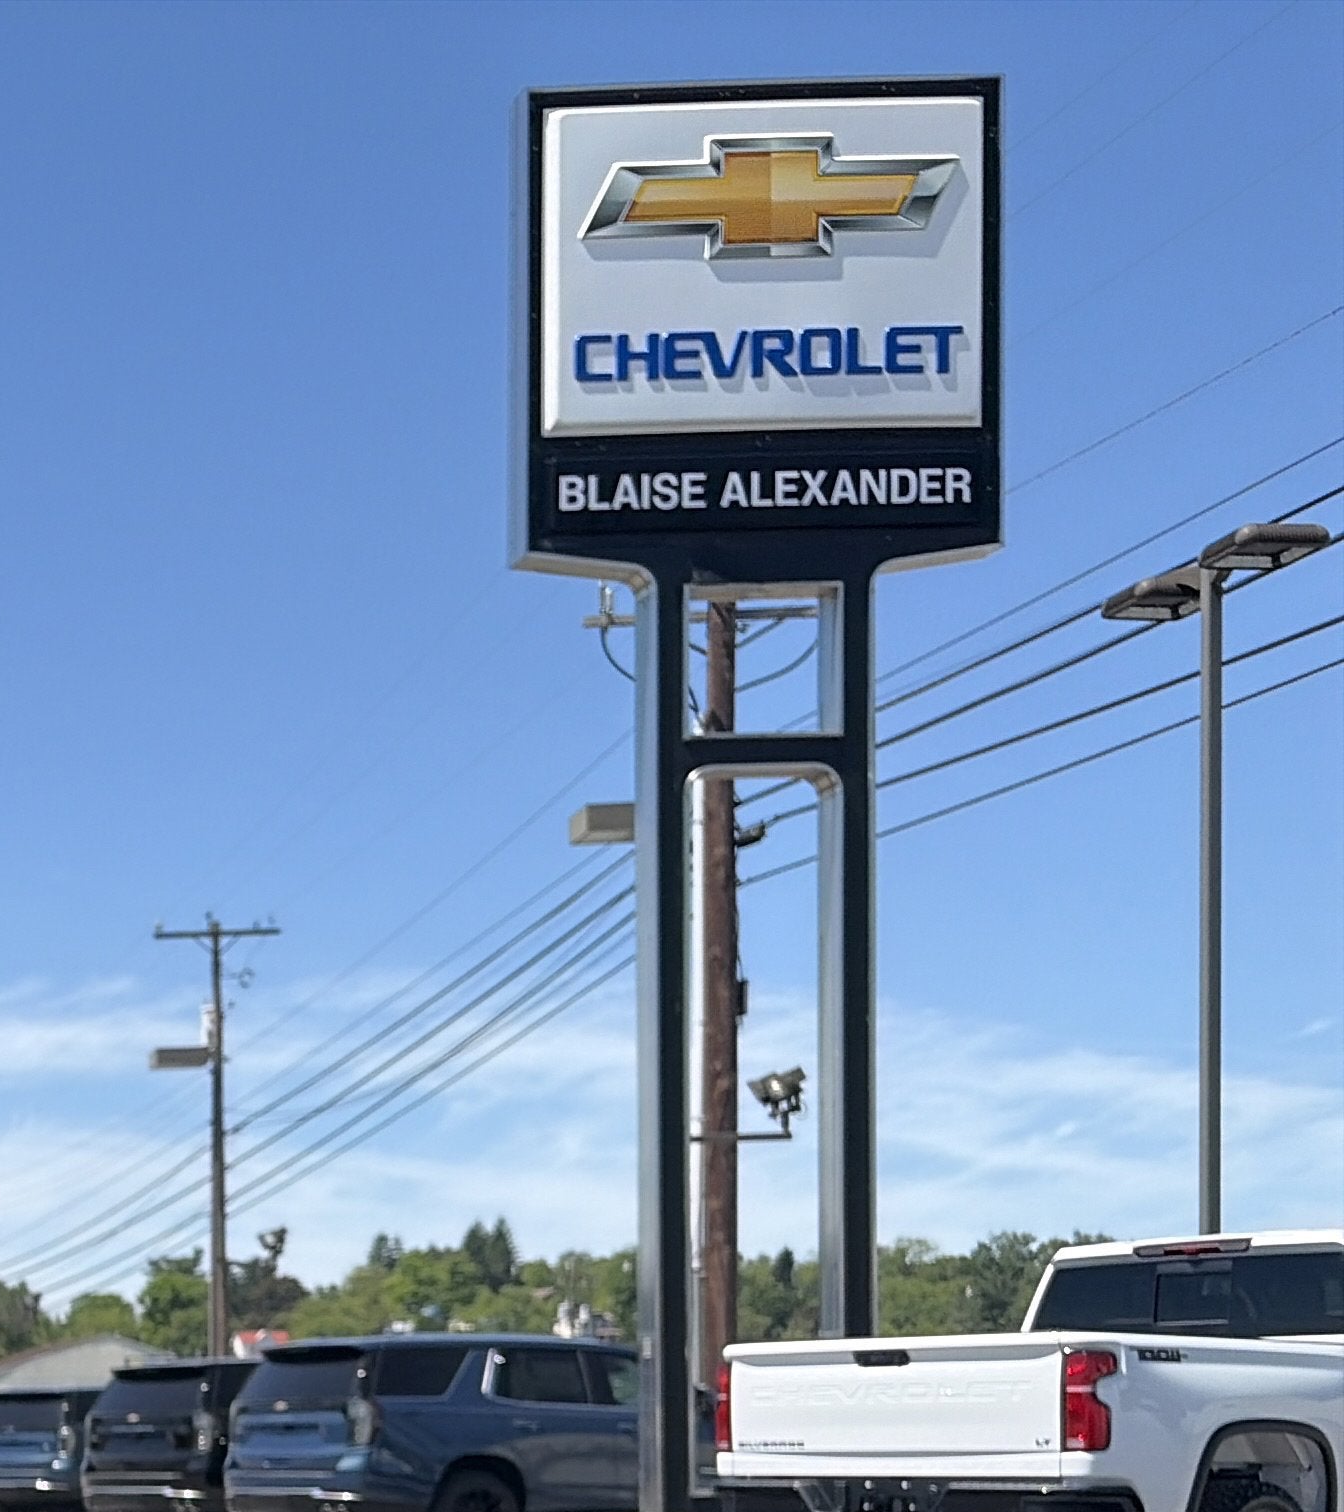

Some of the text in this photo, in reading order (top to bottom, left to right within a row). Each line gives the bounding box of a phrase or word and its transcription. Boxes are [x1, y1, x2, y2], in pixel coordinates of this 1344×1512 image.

[573, 325, 964, 383] CHEVROLET
[557, 467, 973, 512] BLAISE ALEXANDER
[749, 1379, 1032, 1405] CHEVROLET
